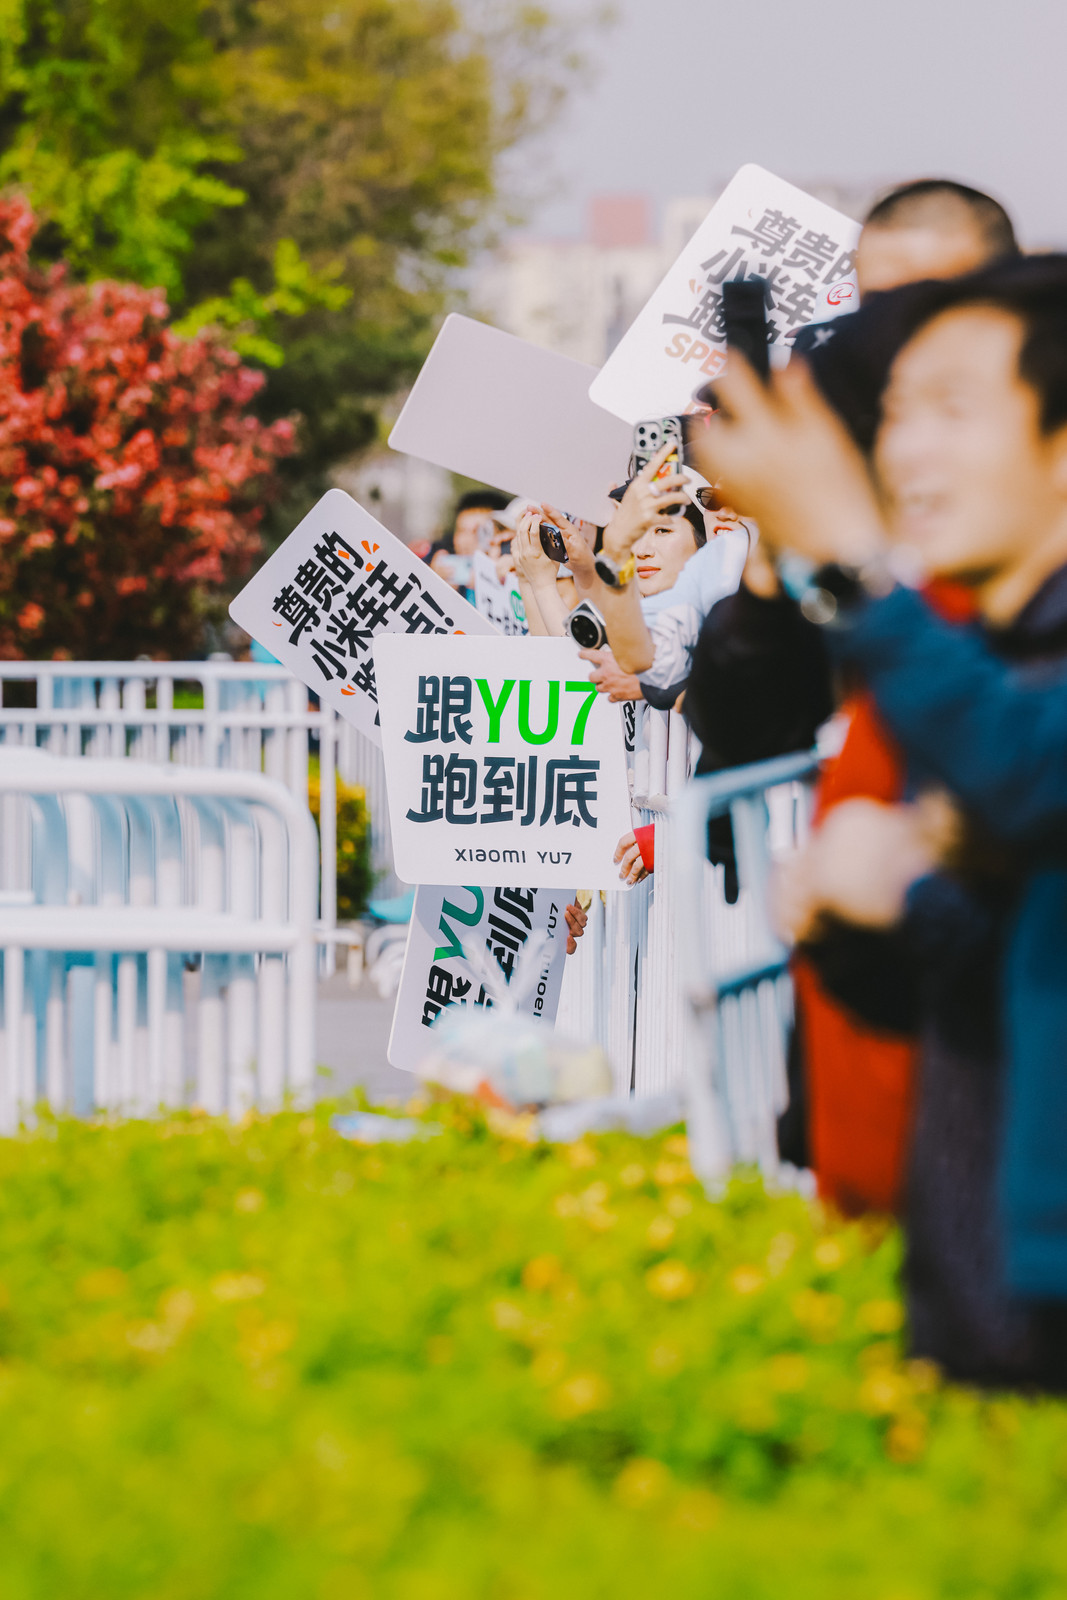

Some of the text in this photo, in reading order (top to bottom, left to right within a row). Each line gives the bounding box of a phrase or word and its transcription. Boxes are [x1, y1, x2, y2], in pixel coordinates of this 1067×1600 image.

[664, 333, 727, 376] SPE
[272, 531, 364, 646] 尊贵的
[406, 753, 600, 828] 跑到底
[537, 851, 573, 865] YU7
